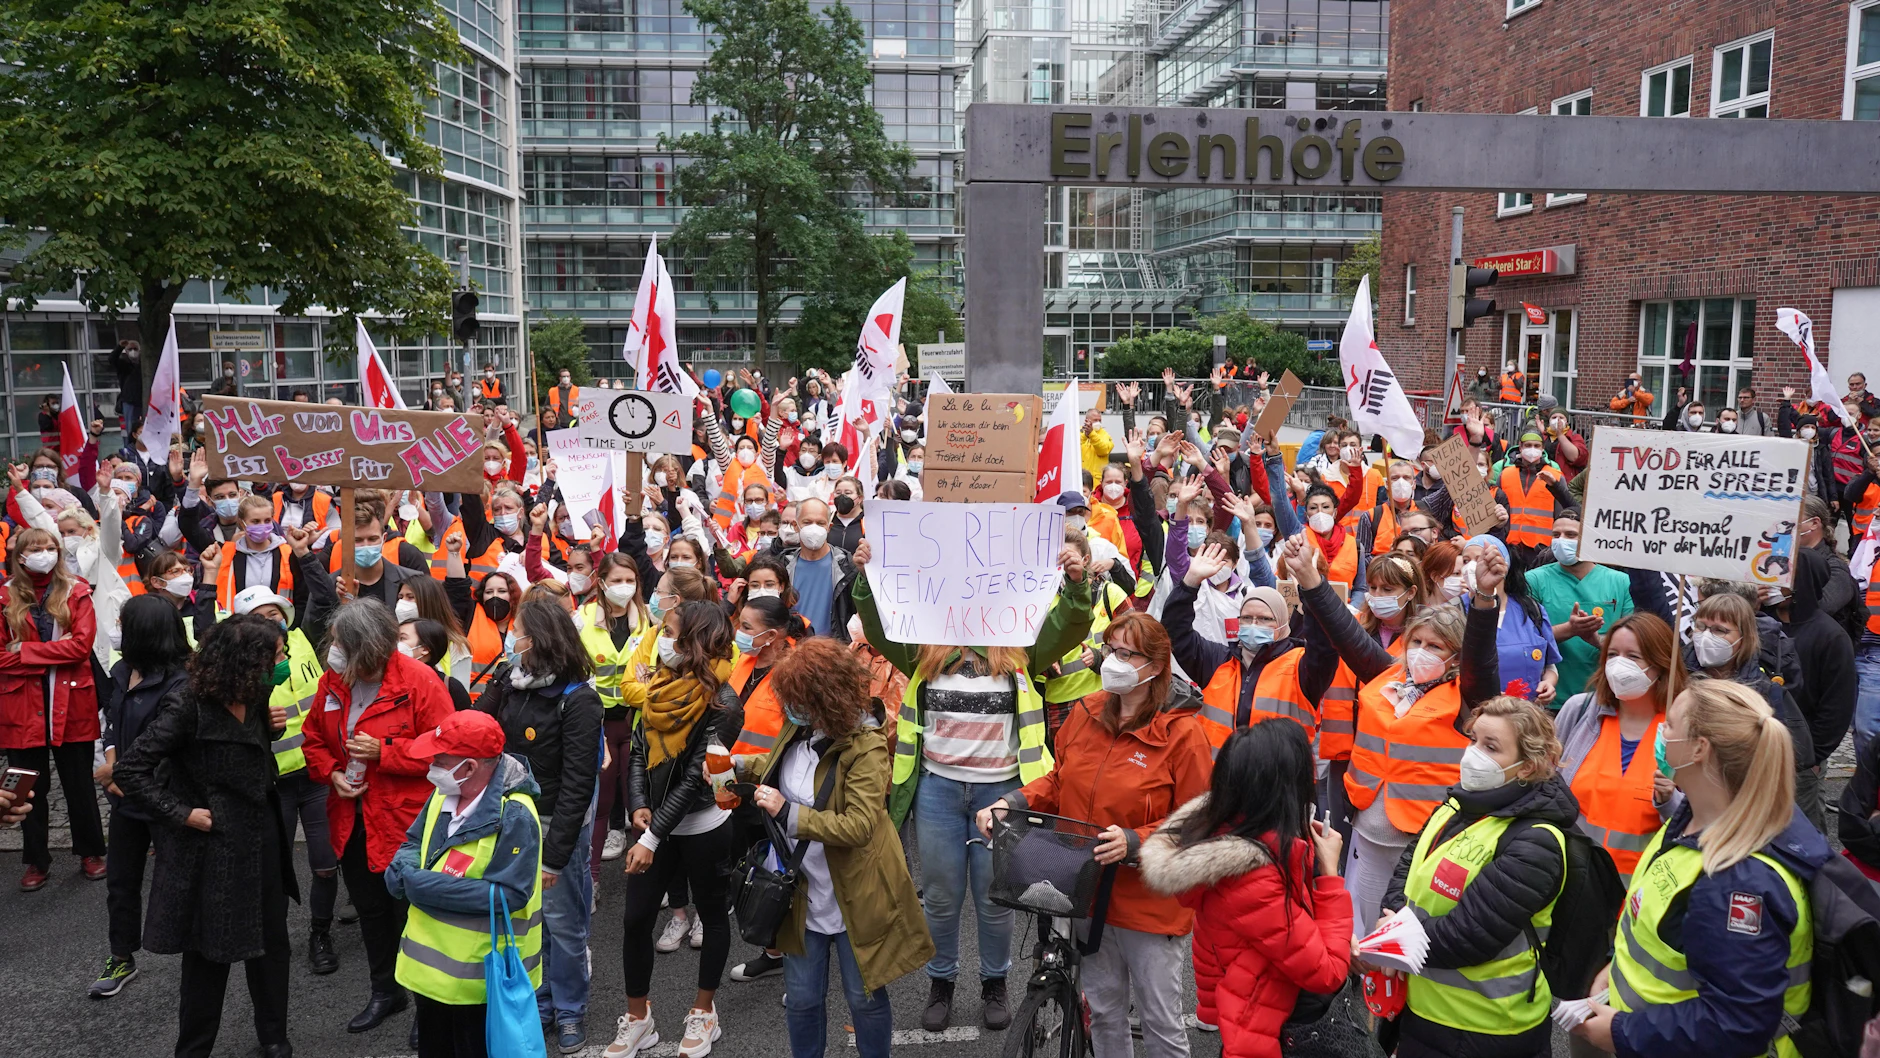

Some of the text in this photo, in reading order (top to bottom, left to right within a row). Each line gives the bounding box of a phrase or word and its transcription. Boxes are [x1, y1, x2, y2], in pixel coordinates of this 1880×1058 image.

[1051, 112, 1405, 182] Erlenhöfe
[1516, 258, 1532, 272] Star
[580, 401, 595, 413] 100
[580, 410, 600, 424] TAGE
[950, 420, 976, 429] schauen
[978, 420, 991, 429] dir
[400, 415, 483, 487] ALLE
[584, 437, 656, 450] TIME IS UP
[1432, 437, 1464, 464] MEHR
[985, 455, 1005, 465] doch
[1441, 452, 1462, 471] VON
[1718, 450, 1761, 469] ALLE
[1443, 460, 1471, 486] UNS
[1453, 474, 1471, 494] IST
[1614, 468, 1799, 494] AN DER SPREE!
[1454, 480, 1488, 510] BESSER
[1466, 501, 1496, 530] ALLE
[1594, 507, 1734, 536] MEHR Personal
[882, 511, 941, 569] ES
[1594, 536, 1752, 562] noch vor der Wahl!
[1433, 876, 1461, 898] ver.di
